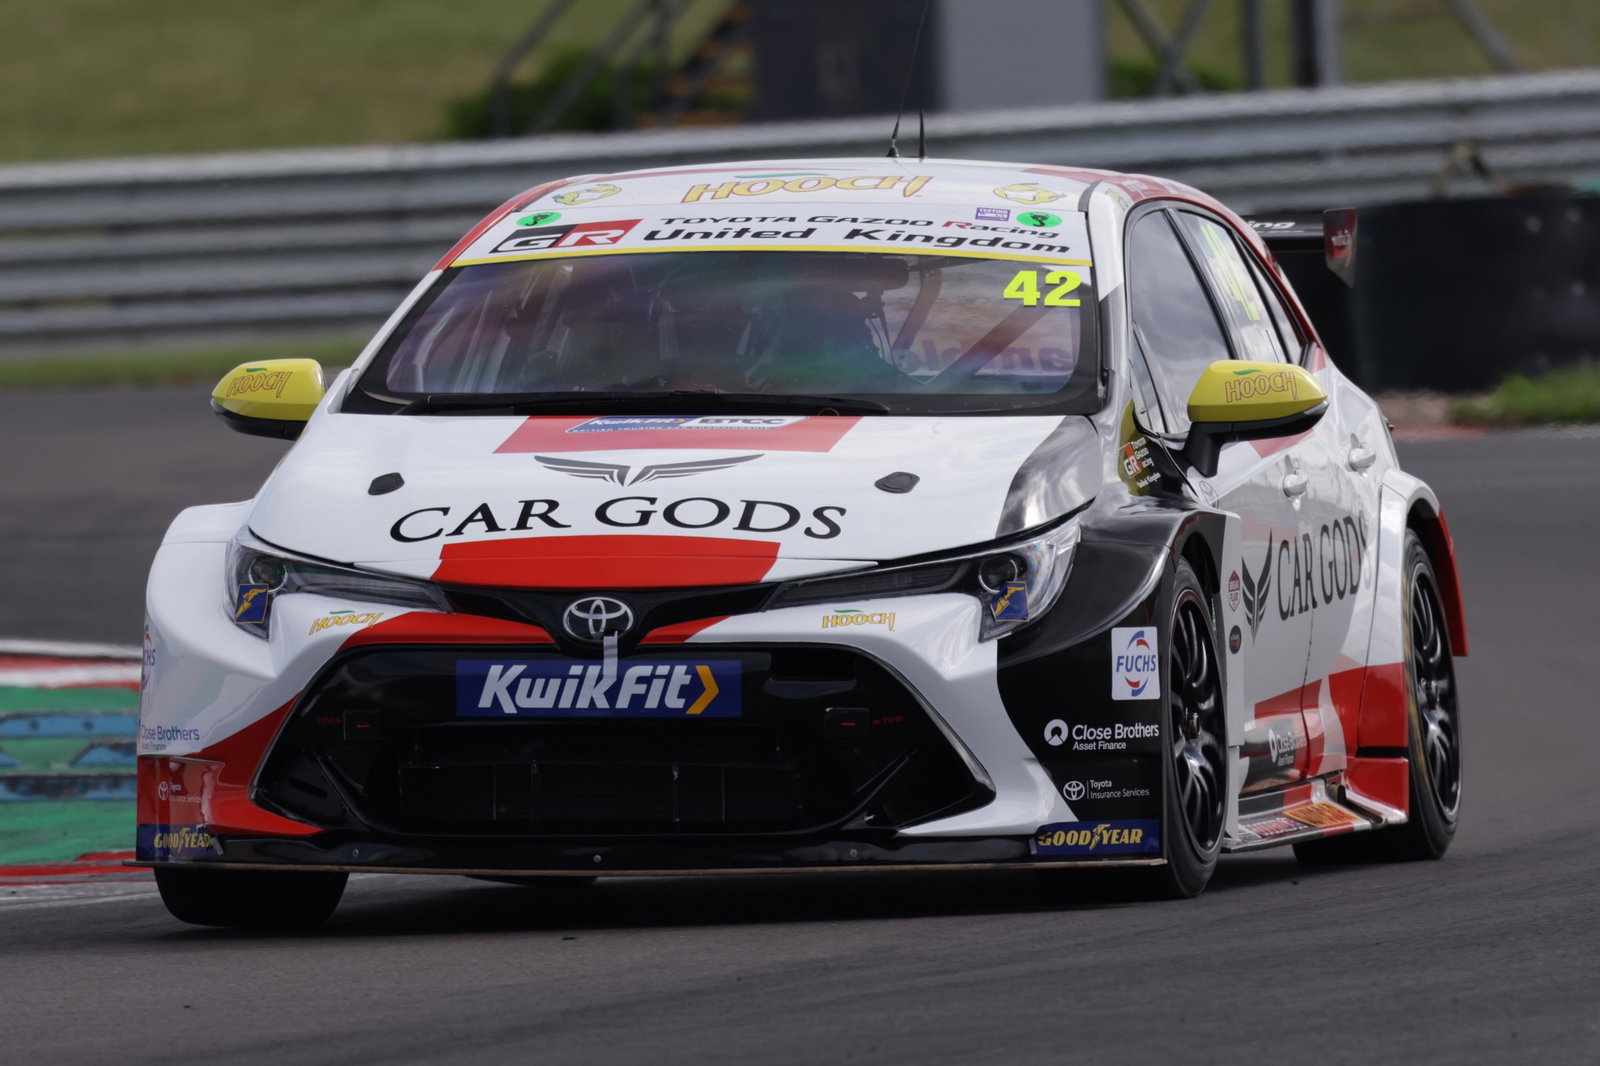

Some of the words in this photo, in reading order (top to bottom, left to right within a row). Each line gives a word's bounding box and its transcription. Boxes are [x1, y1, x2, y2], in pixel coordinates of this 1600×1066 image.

[680, 175, 934, 204] HOOCH
[660, 215, 798, 226] TOYOTA
[941, 220, 1060, 239] Racing
[1248, 220, 1297, 230] ing
[496, 228, 626, 252] GR
[643, 226, 819, 242] United
[843, 228, 1071, 254] Kingdom
[1003, 270, 1081, 307] 42
[226, 371, 293, 399] HOOCH
[1224, 371, 1299, 404] HOOCH
[389, 499, 573, 543] CAR
[594, 496, 847, 540] GODS
[1277, 532, 1318, 621] CAR
[1319, 509, 1372, 606] GODS
[309, 612, 385, 636] HOOCH
[821, 612, 896, 632] HOOCH
[1115, 654, 1157, 673] FUCHS
[157, 725, 200, 741] Brothers
[1072, 723, 1112, 741] Close
[1114, 722, 1160, 740] Brothers
[1072, 741, 1097, 751] Asset
[1098, 740, 1127, 750] Finance
[1089, 779, 1113, 790] Toyota
[1090, 789, 1121, 799] Insurance
[1122, 787, 1150, 798] Services
